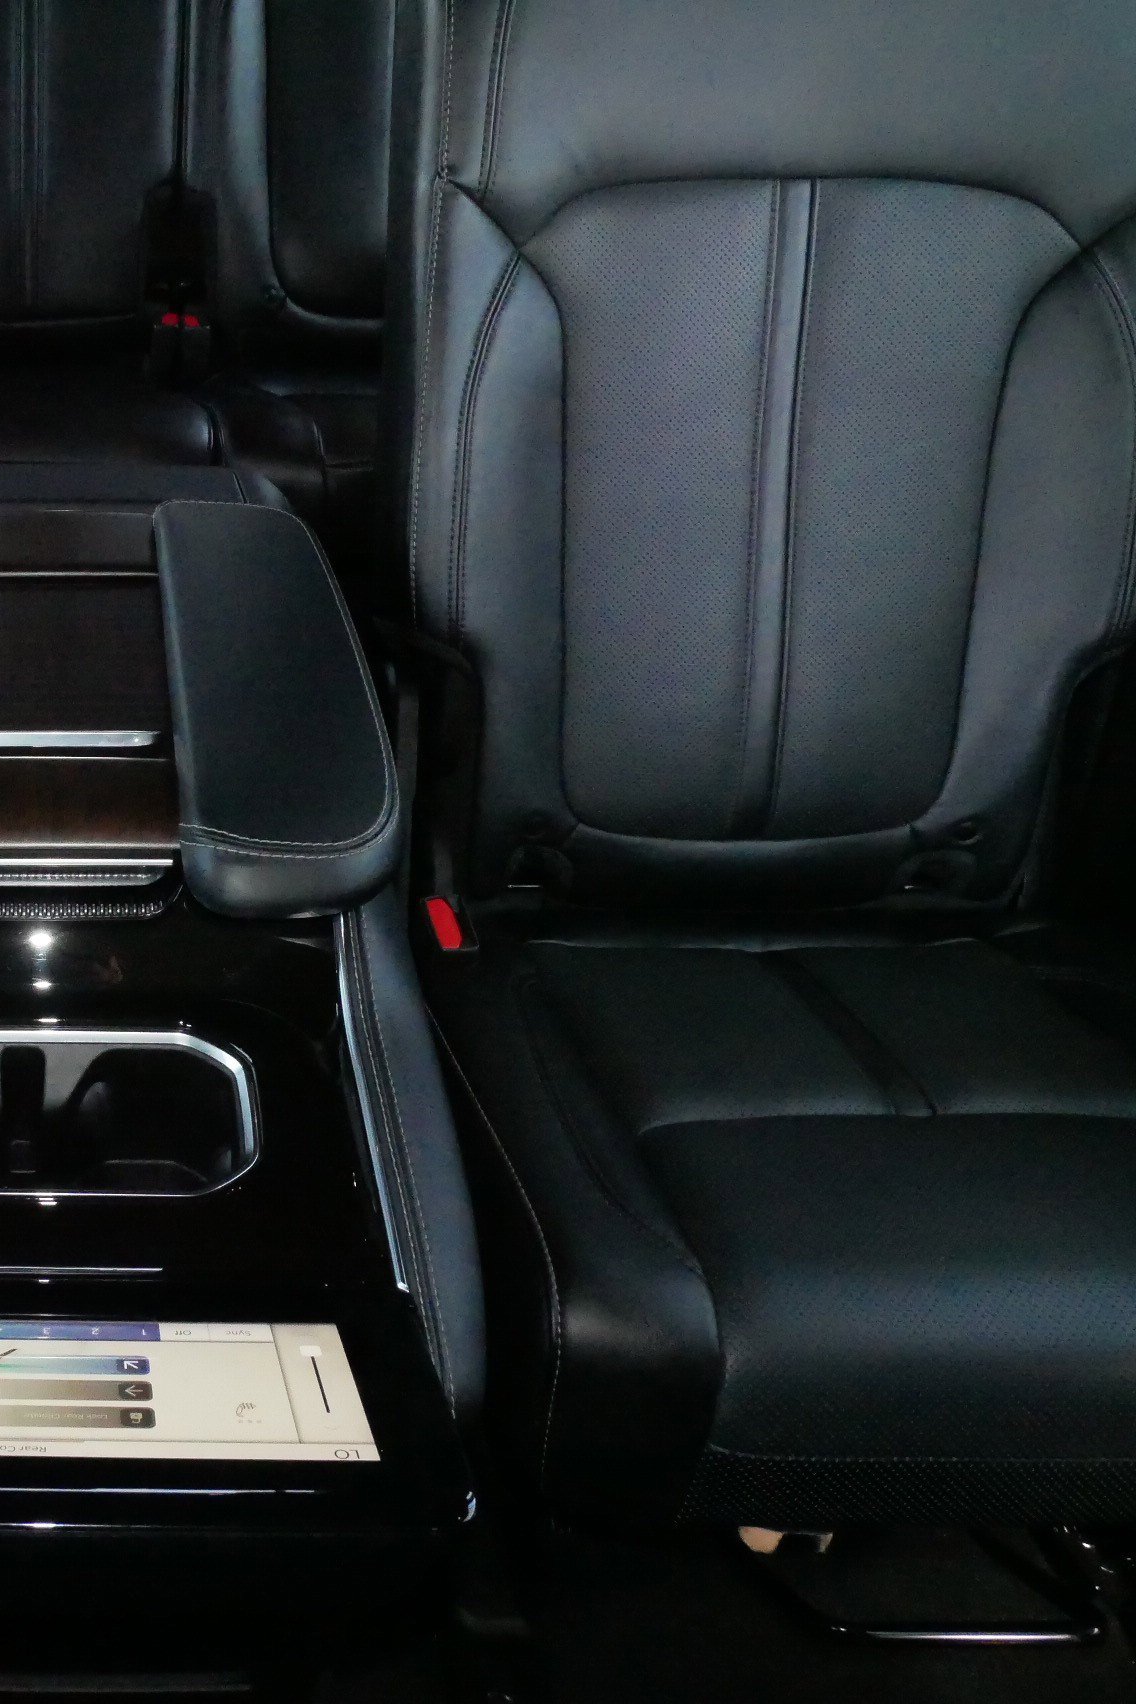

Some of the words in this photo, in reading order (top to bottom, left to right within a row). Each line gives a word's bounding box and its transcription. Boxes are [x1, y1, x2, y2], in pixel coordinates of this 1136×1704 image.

[43, 1326, 51, 1334] 3
[91, 1327, 100, 1336] 2
[141, 1328, 147, 1336] 1
[226, 1329, 251, 1337] Sync
[19, 1445, 47, 1453] Rear
[334, 1449, 360, 1460] LO
